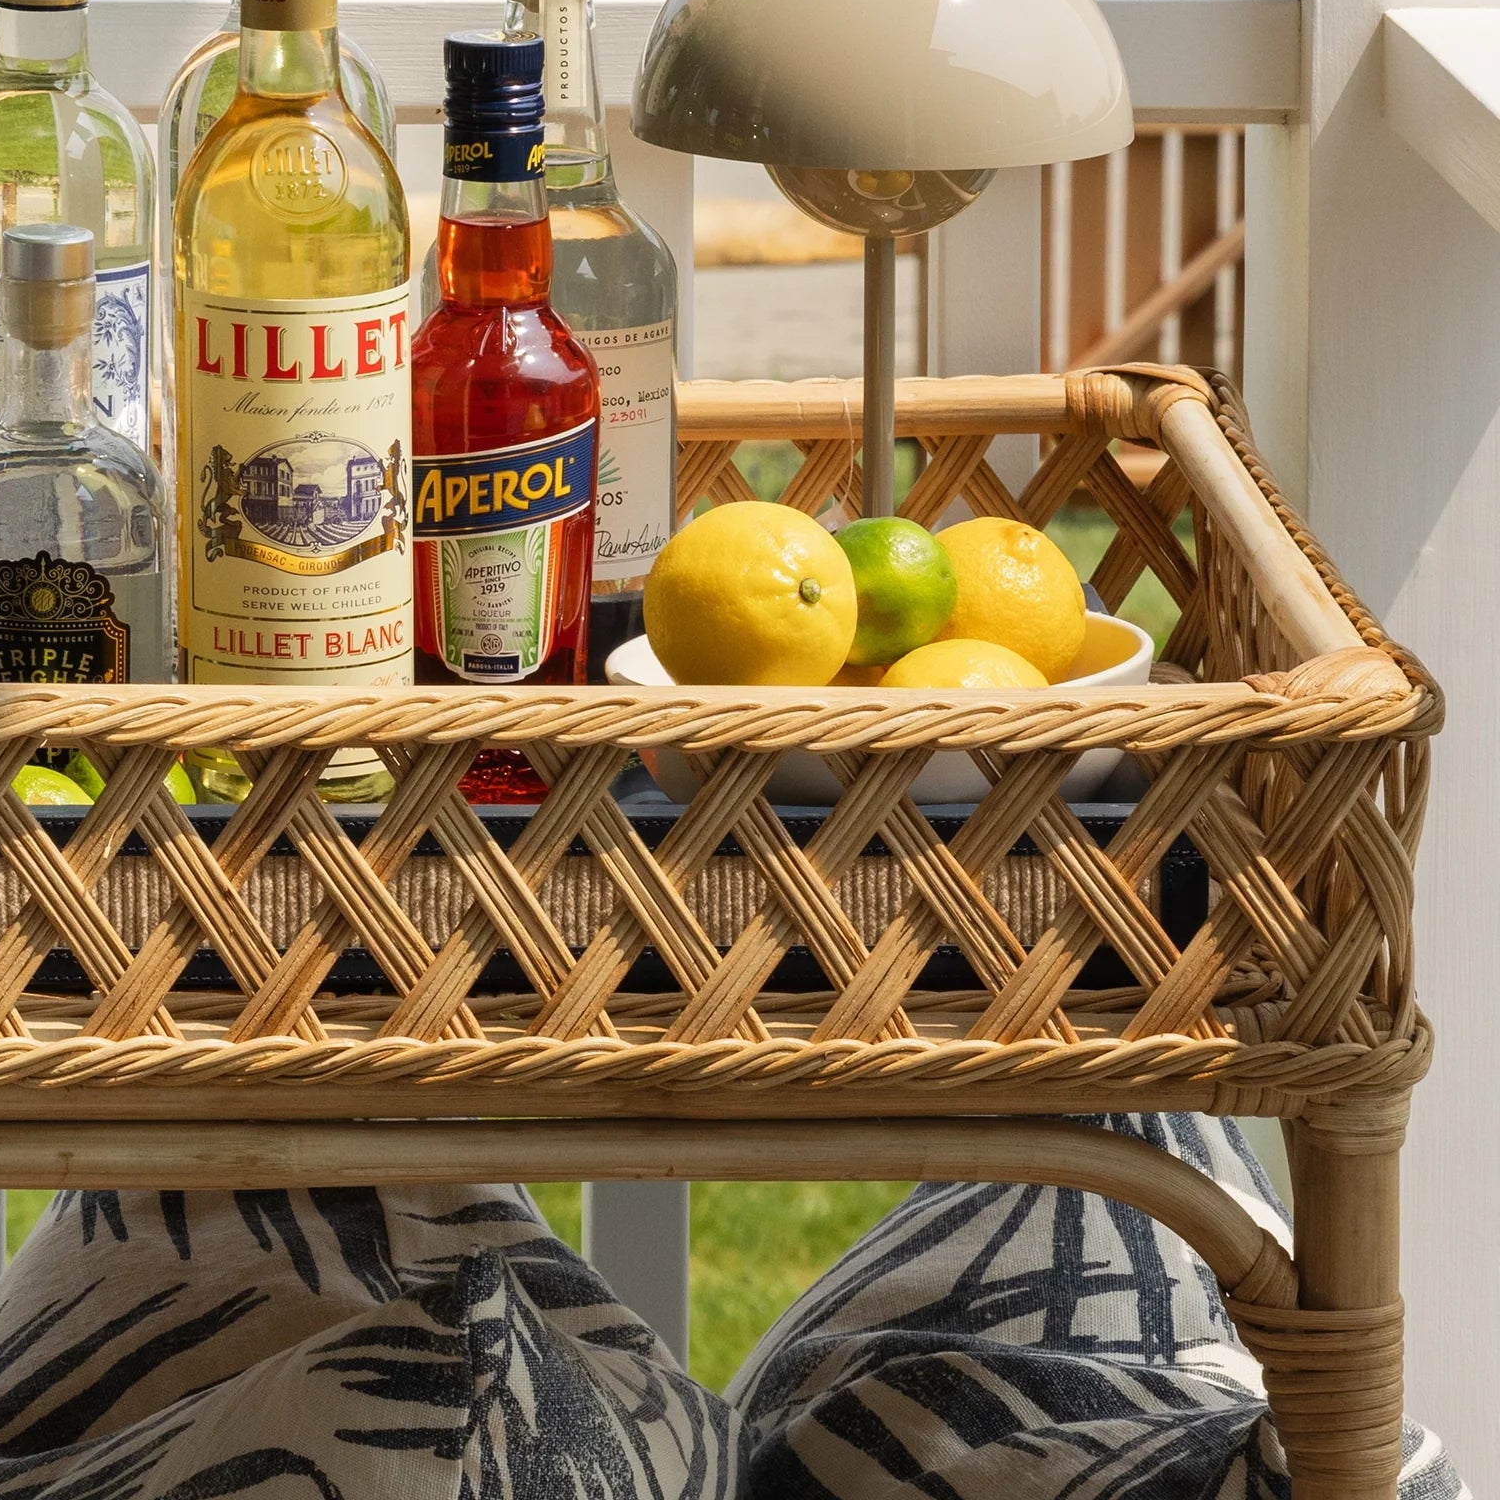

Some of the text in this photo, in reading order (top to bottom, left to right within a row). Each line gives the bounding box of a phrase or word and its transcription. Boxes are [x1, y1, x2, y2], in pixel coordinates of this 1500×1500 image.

[559, 5, 570, 100] PRODUCTOS
[263, 146, 332, 176] LILLET
[445, 141, 494, 165] APEROL
[453, 164, 470, 174] 1919
[275, 180, 327, 201] 1872
[625, 333, 638, 343] DE
[643, 326, 669, 340] AGAVE
[195, 310, 408, 383] LILLET
[223, 391, 288, 416] Maison
[345, 403, 361, 413] en
[366, 392, 395, 411] 1872
[637, 387, 669, 402] Mexico
[610, 409, 647, 423] 23091
[416, 456, 572, 525] APEROL
[464, 560, 522, 580] APERITIVO
[243, 581, 381, 596] PRODUCT OF FRANCE
[480, 582, 506, 595] 1919
[242, 595, 382, 611] SERVE WELL CHILLED
[472, 609, 512, 618] LIQUEUR
[39, 635, 95, 643] NANTUCKET
[213, 620, 405, 660] LILLET BLANC
